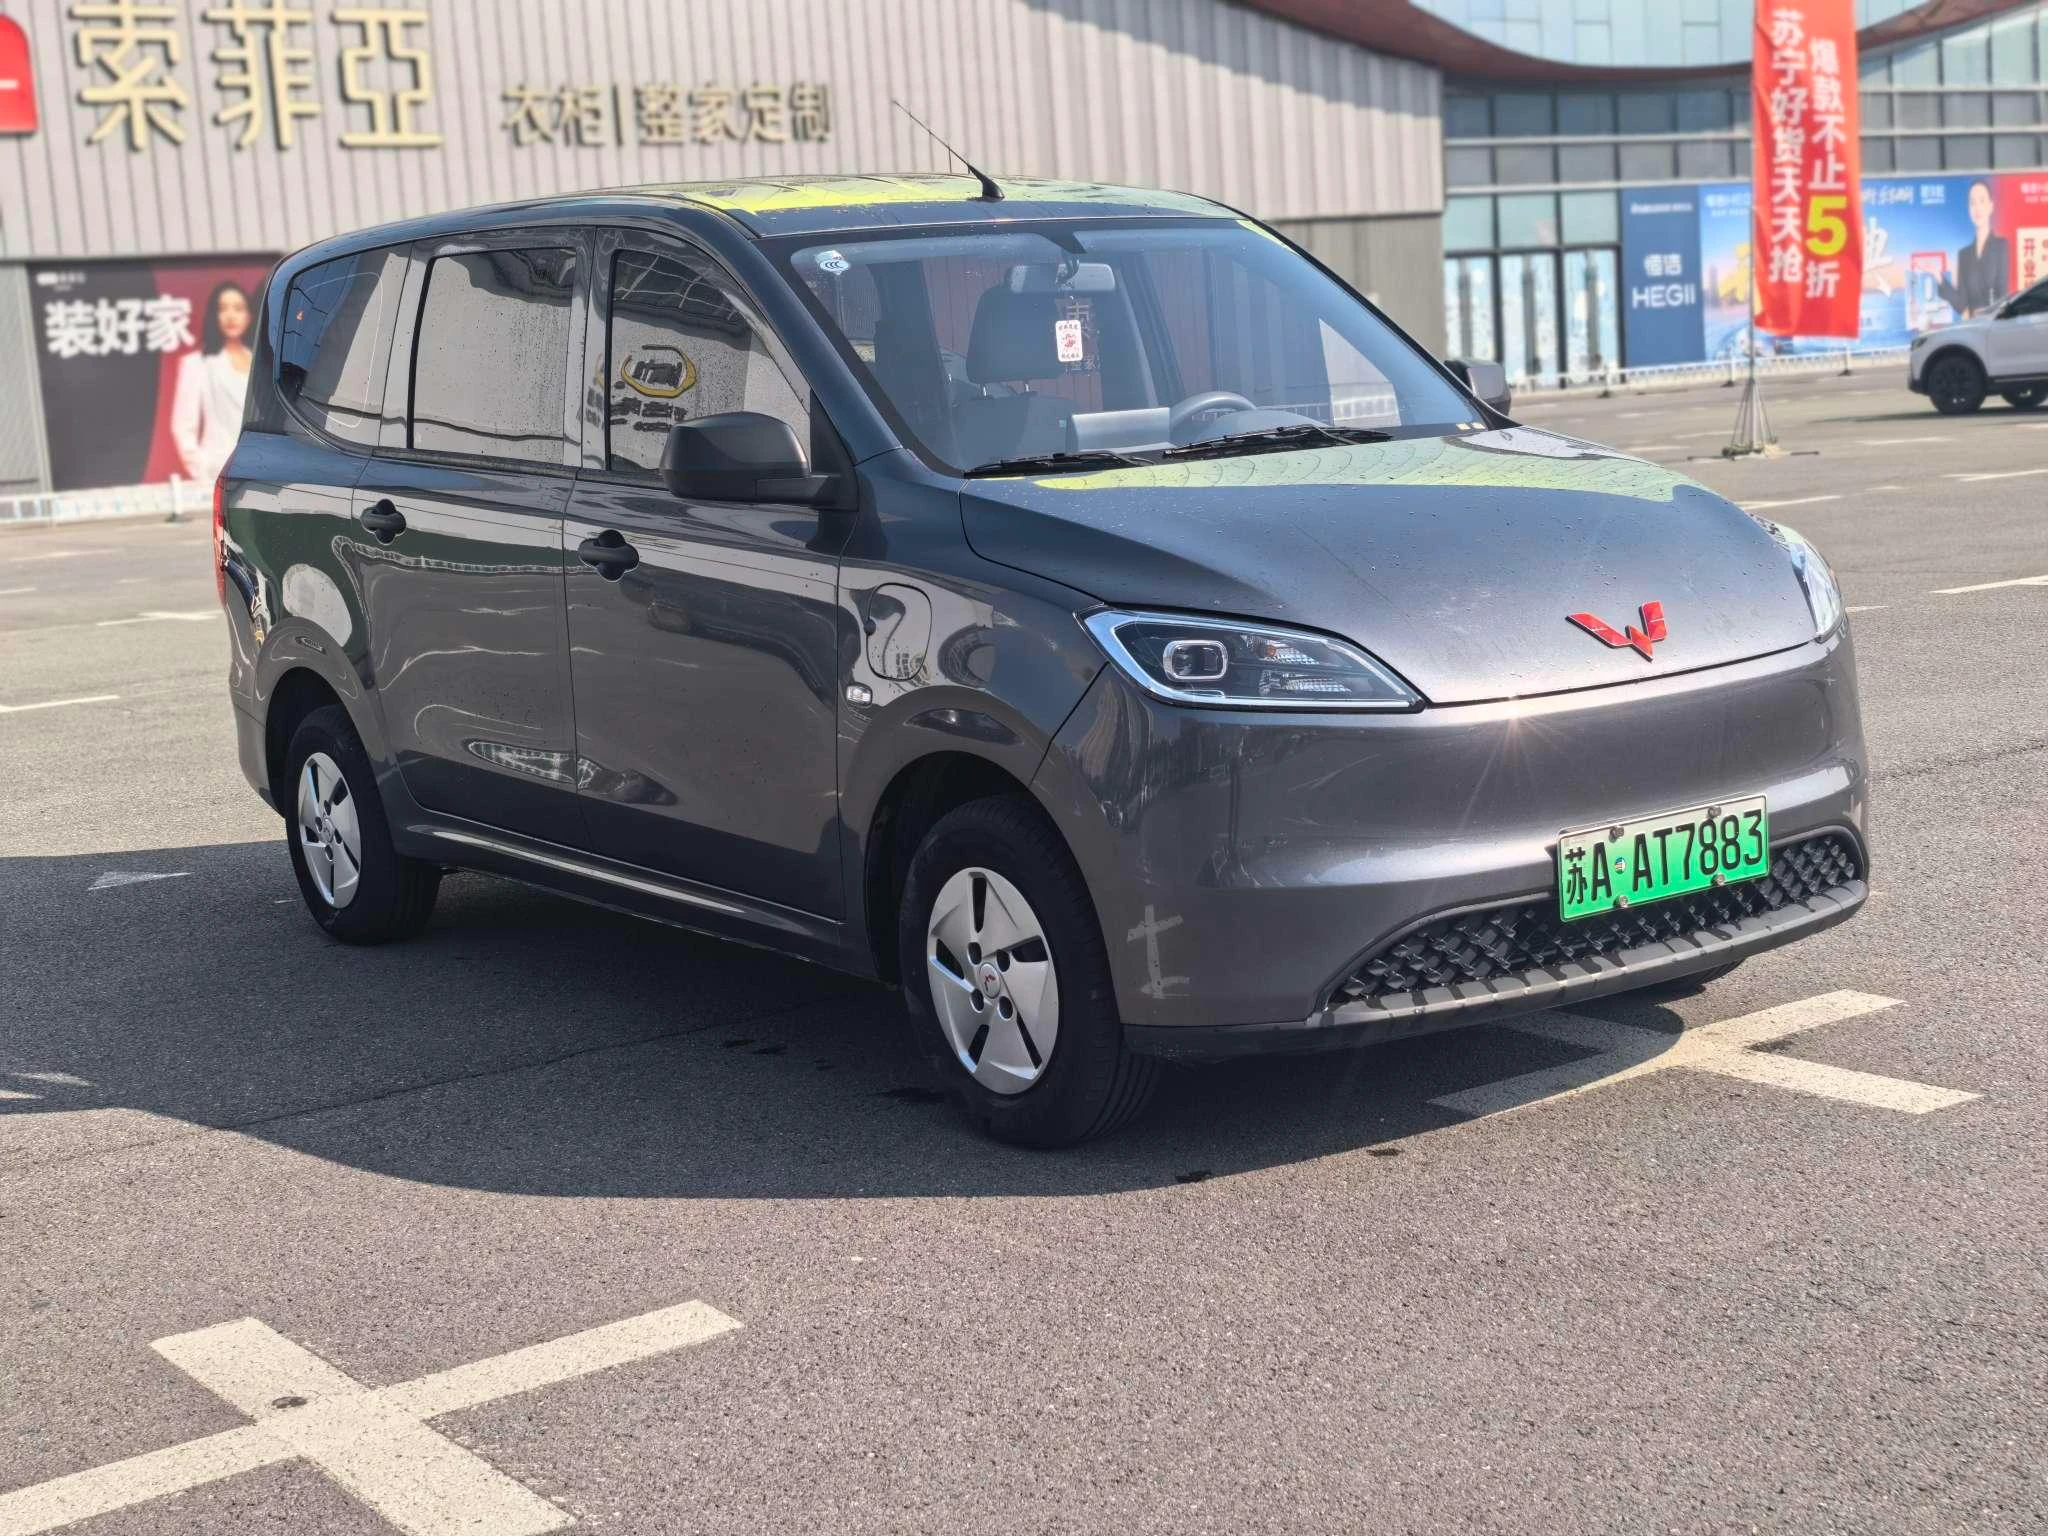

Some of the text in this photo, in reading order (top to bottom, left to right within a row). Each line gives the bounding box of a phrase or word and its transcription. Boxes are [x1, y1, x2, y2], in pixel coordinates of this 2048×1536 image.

[68, 0, 443, 150] 索菲亞
[1768, 8, 1808, 284] 苏宁好货天天抢
[45, 295, 195, 358] 装好家
